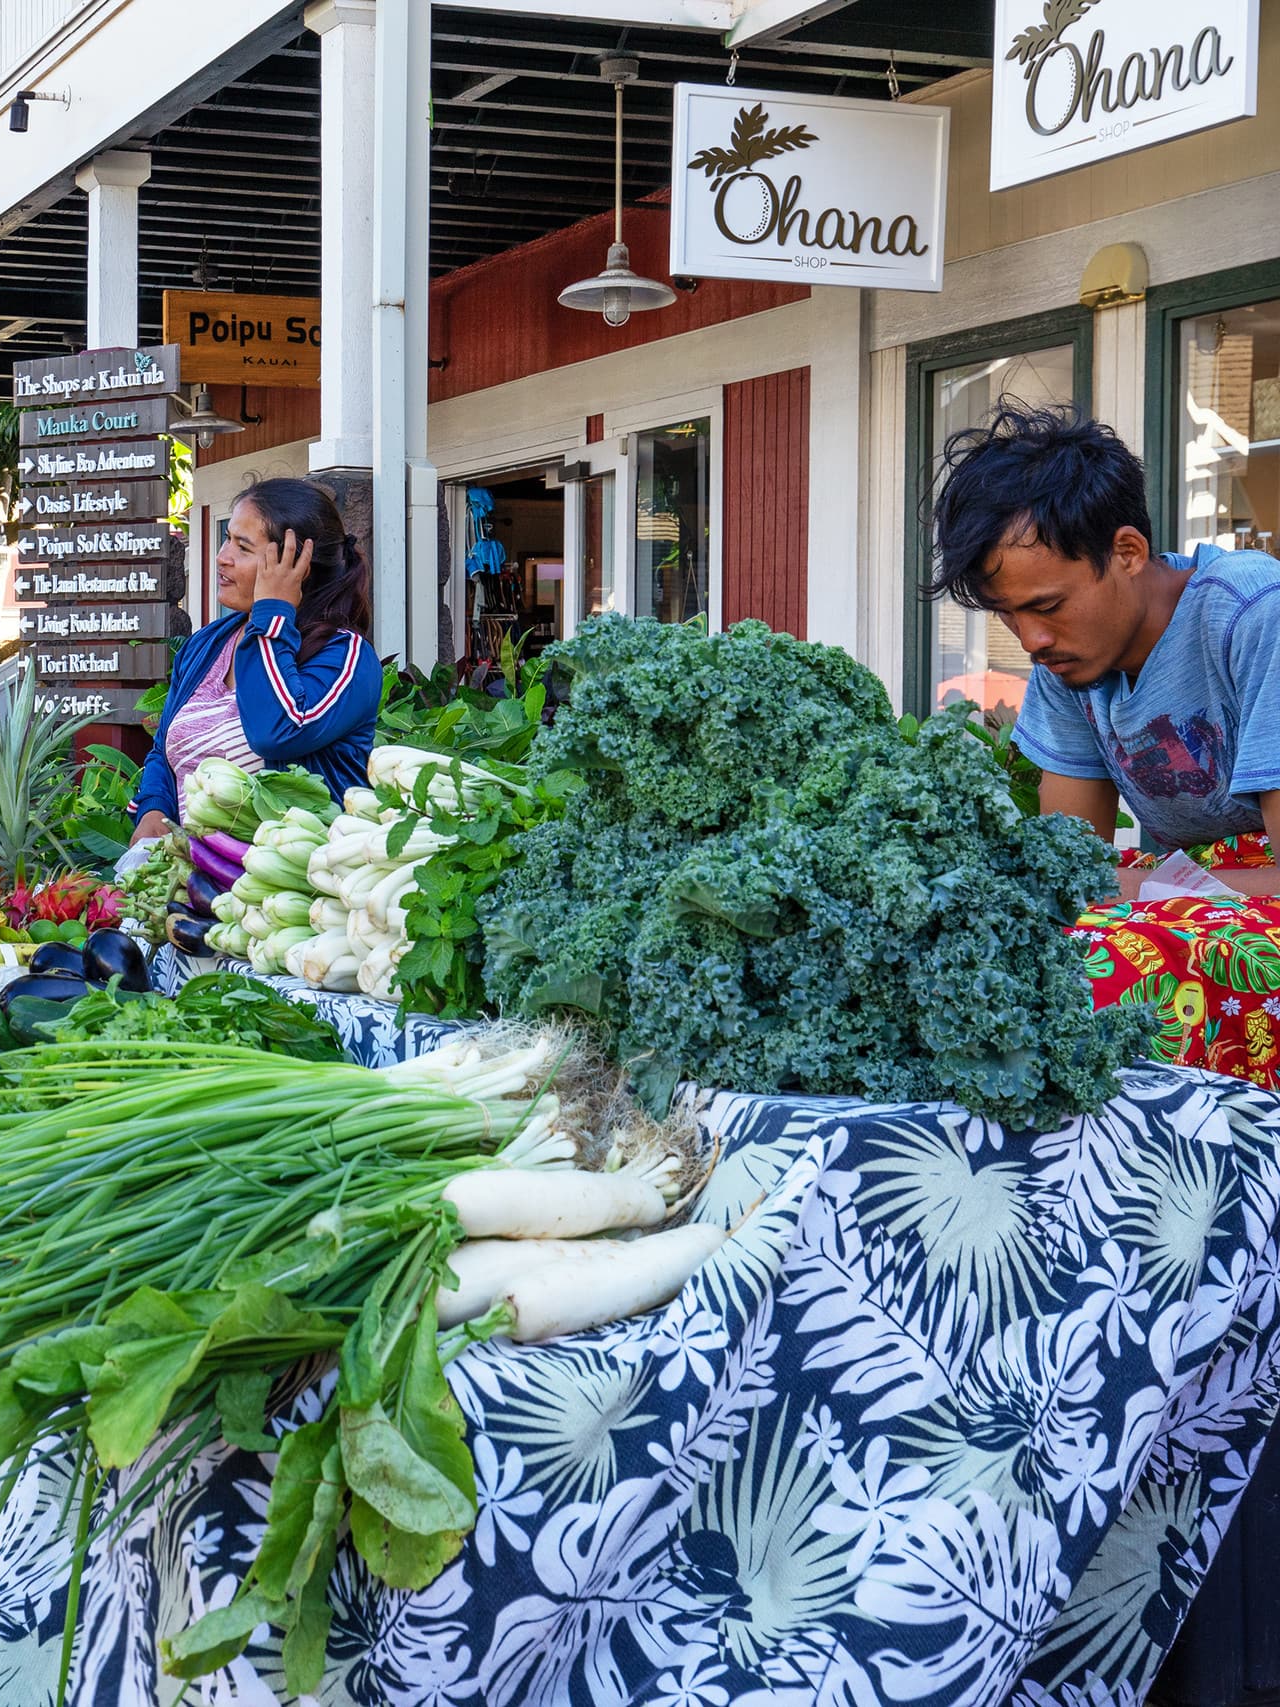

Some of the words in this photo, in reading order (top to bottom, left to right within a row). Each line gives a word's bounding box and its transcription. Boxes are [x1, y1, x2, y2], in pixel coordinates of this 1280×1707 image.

[1023, 26, 1235, 136] Ohana
[1098, 121, 1130, 143] SHOP
[709, 171, 929, 257] Ohana
[794, 255, 828, 269] SHOP
[189, 311, 272, 347] Poipu
[242, 356, 298, 367] KAUAI
[15, 373, 42, 397] The
[42, 373, 80, 399] Shops
[81, 375, 96, 392] at
[37, 414, 89, 437] Mauka
[92, 411, 138, 431] Court
[37, 453, 76, 478] Skyline
[76, 452, 96, 473] Eco
[97, 450, 156, 472] Adventures
[36, 494, 71, 514] Oasis
[73, 490, 128, 515] Lifestyle
[38, 535, 75, 559] Poipu
[77, 534, 99, 553] Sol
[99, 533, 113, 553] &
[114, 531, 162, 556] Slipper
[33, 574, 52, 594] The
[52, 573, 78, 594] Lanai
[78, 573, 128, 592] Restaurant
[128, 572, 138, 592] &
[139, 571, 158, 592] Bar
[37, 613, 70, 636] Living
[69, 612, 101, 632] Foods
[100, 611, 140, 632] Market
[37, 654, 68, 674] Tori
[68, 651, 120, 673] Richard
